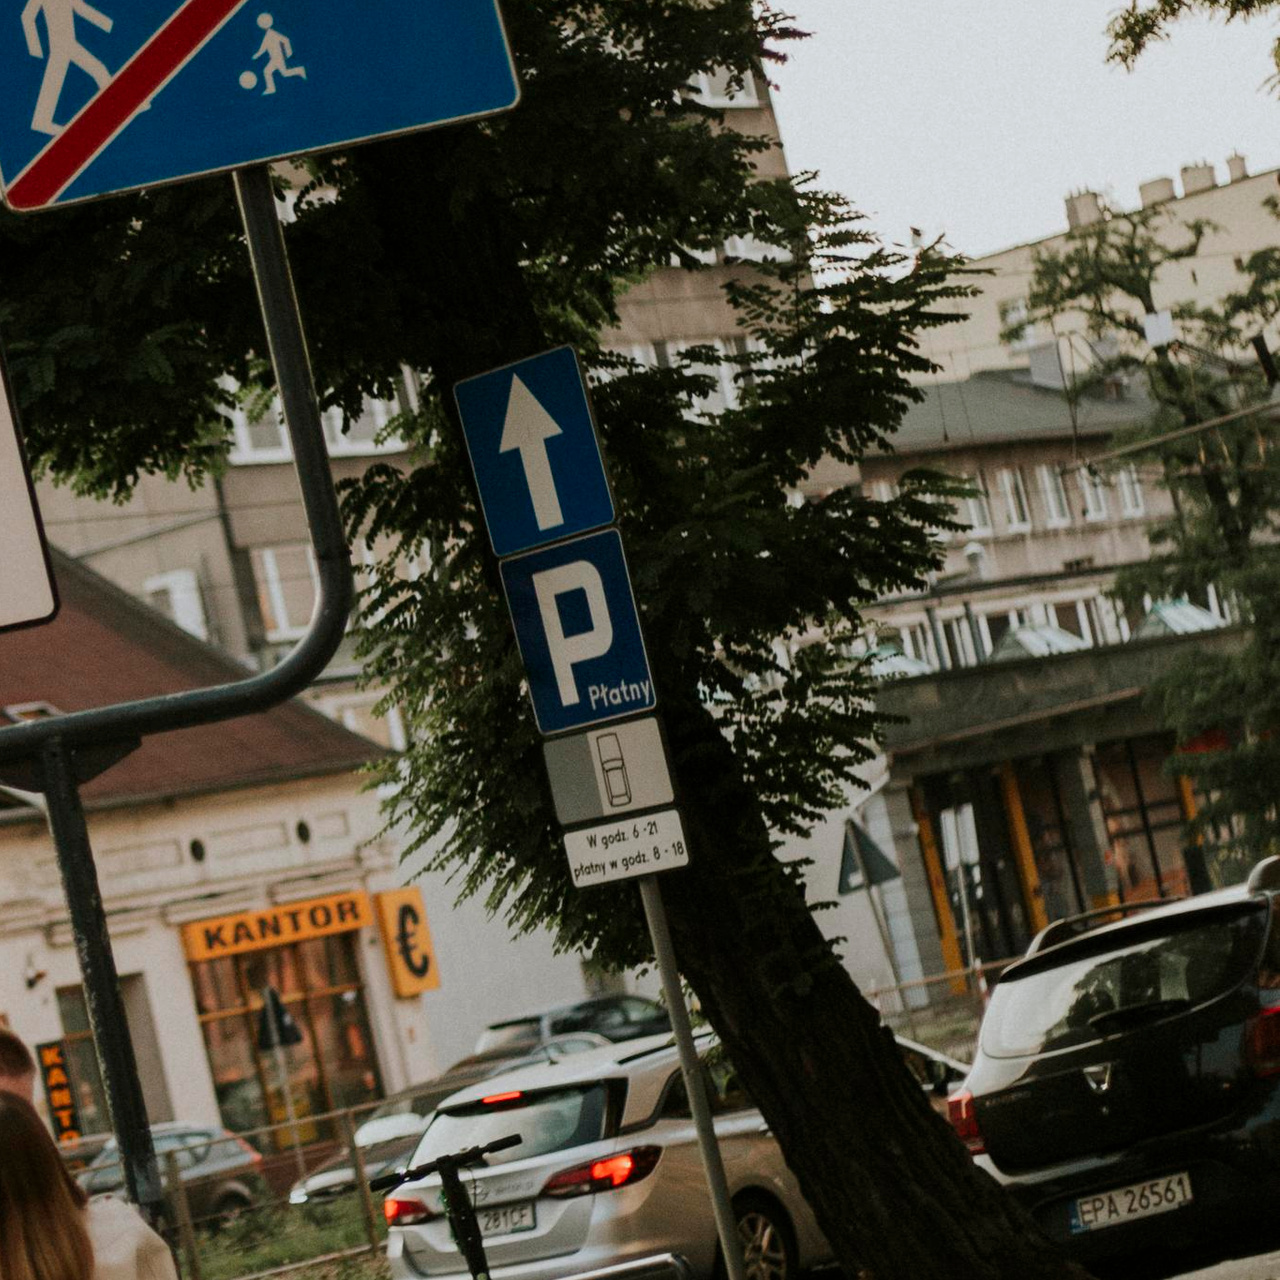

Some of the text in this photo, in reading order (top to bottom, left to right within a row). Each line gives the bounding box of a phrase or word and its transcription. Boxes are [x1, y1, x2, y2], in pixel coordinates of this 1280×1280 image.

[532, 560, 614, 707] P
[588, 679, 650, 710] Płatny
[601, 829, 629, 849] godz.
[632, 824, 639, 839] 6
[574, 862, 606, 881] płatny
[609, 861, 618, 870] w
[621, 850, 650, 871] godz.
[653, 846, 660, 860] 8
[672, 840, 684, 856] 18
[204, 900, 360, 950] KANTOR
[1081, 1177, 1187, 1225] EPA 26561
